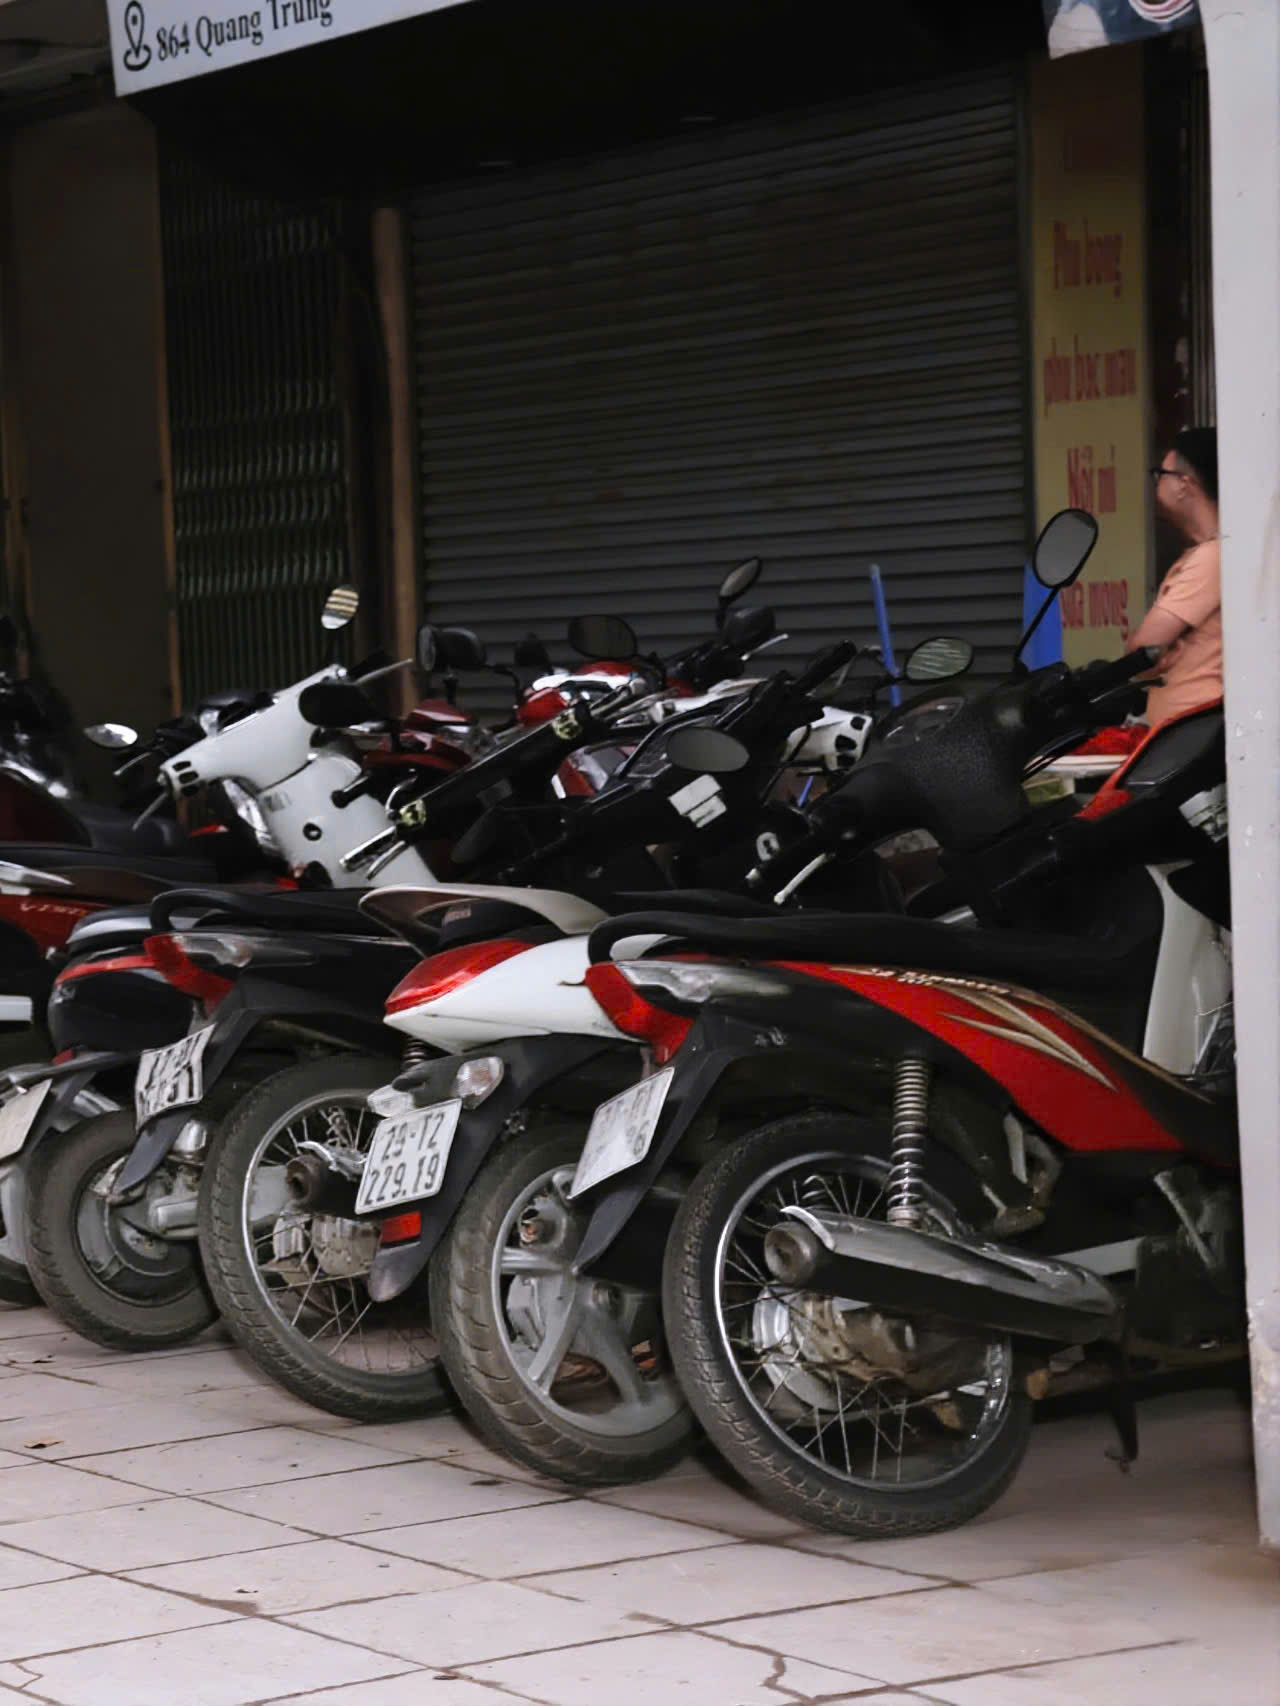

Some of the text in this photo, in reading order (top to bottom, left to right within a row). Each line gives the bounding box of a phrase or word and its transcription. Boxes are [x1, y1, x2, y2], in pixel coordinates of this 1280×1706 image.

[156, 0, 333, 61] 864 Quang Trung
[381, 1112, 445, 1162] 29-T2
[363, 1152, 440, 1206] 229.19
